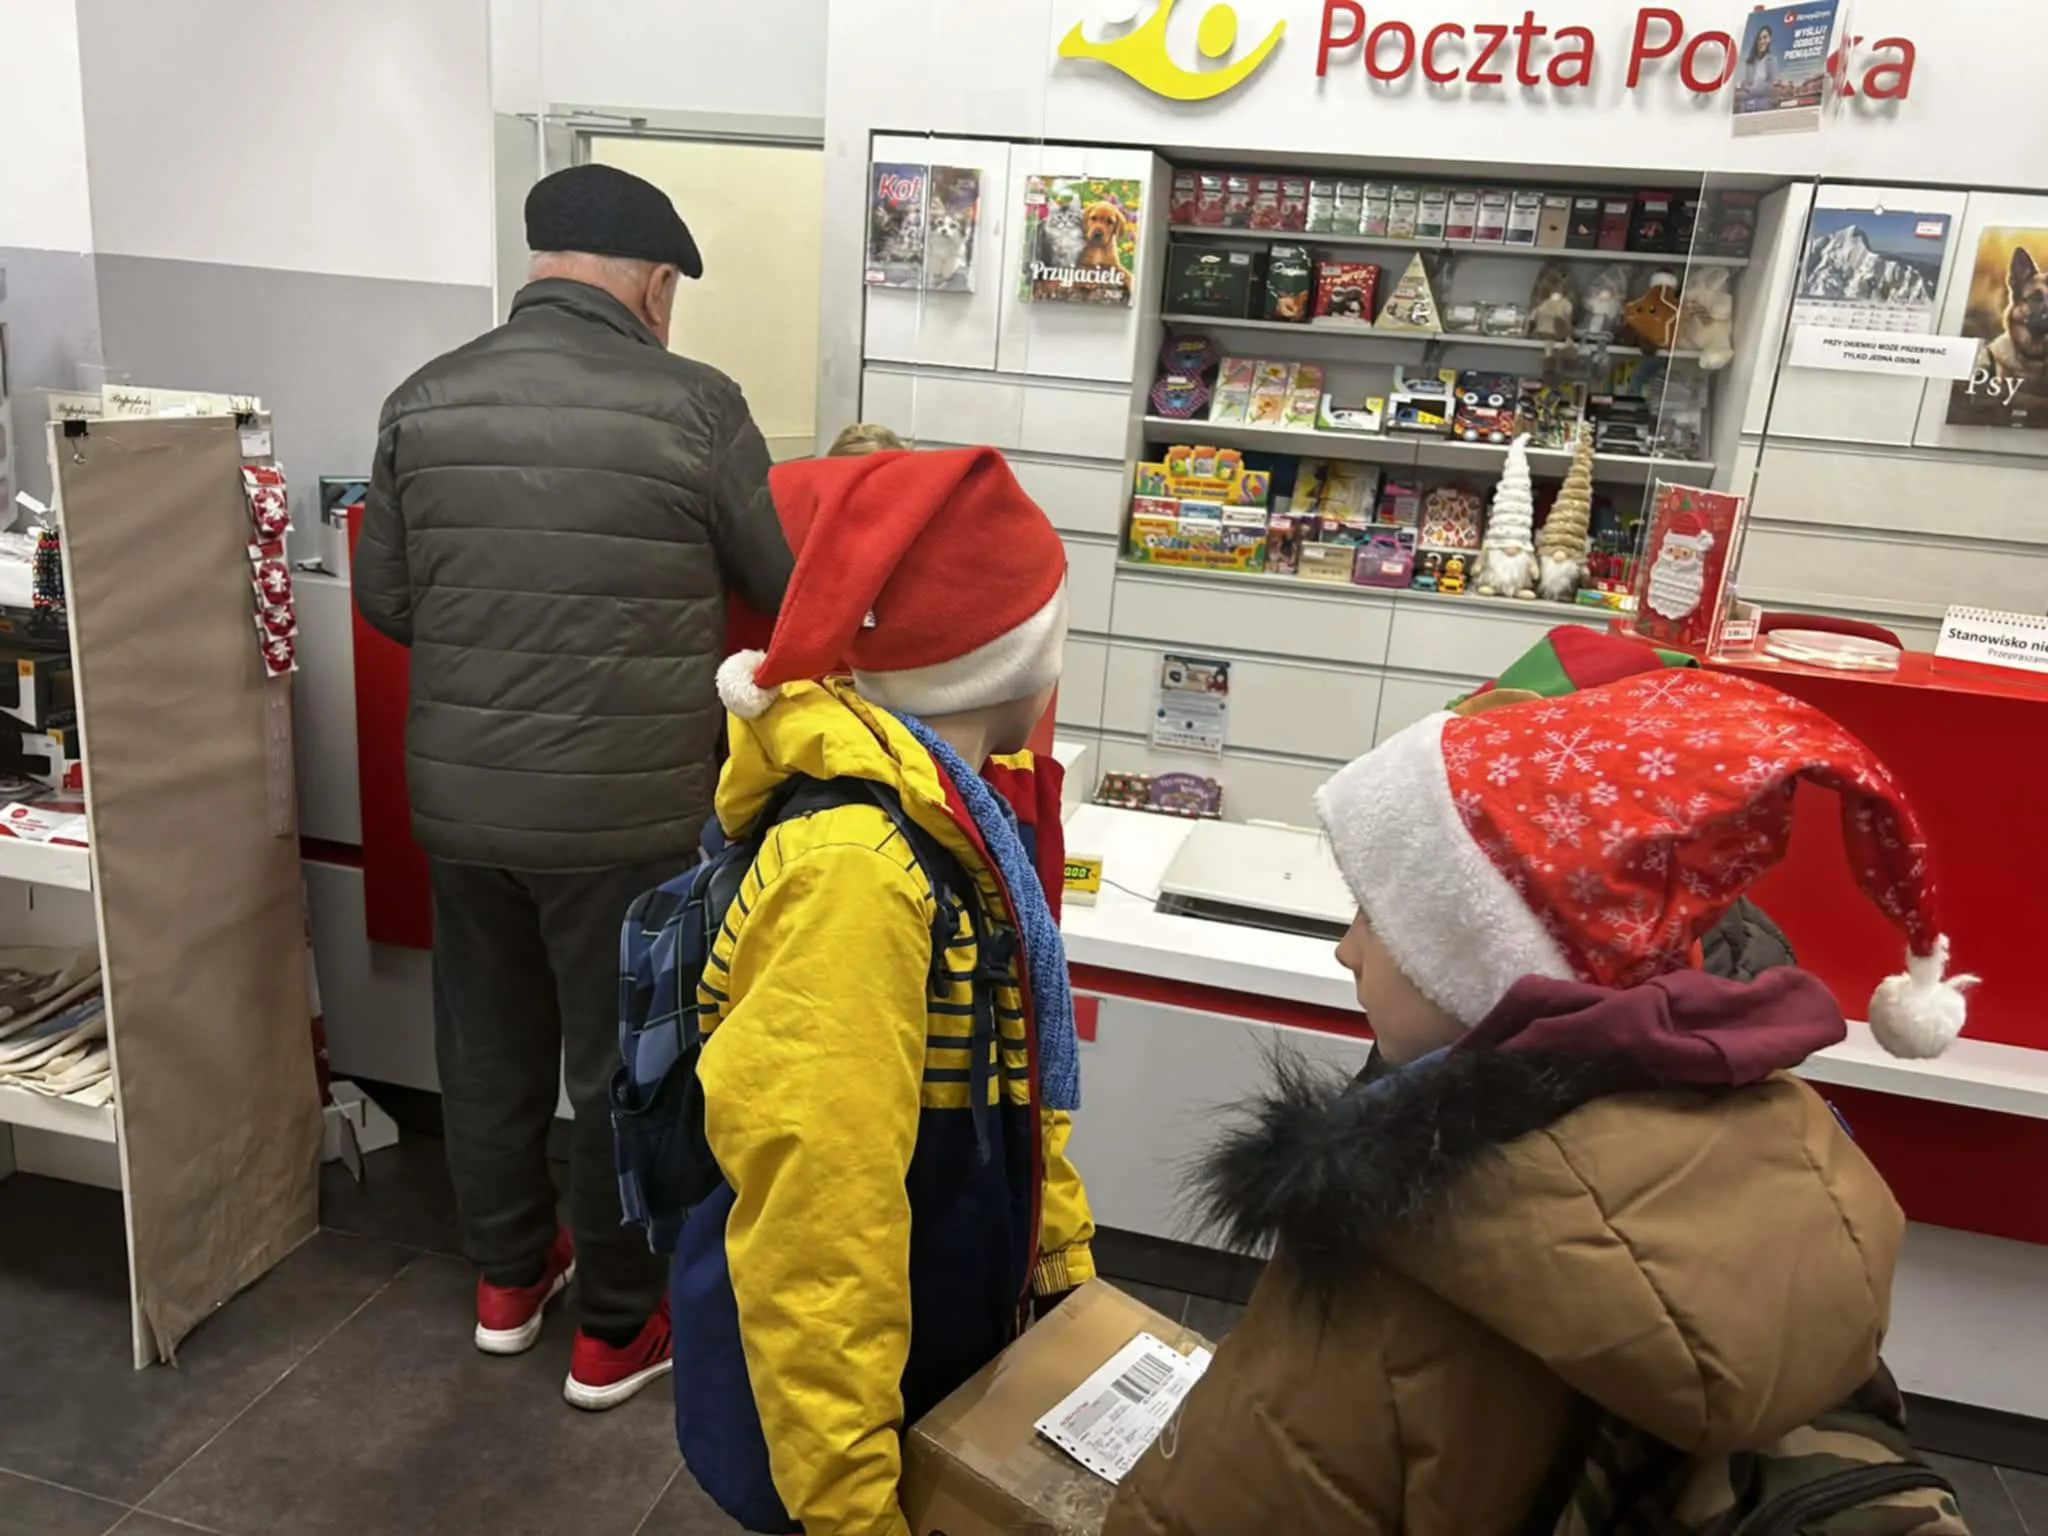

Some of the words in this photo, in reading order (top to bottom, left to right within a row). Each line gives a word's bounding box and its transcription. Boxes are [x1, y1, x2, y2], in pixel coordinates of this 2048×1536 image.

[1316, 0, 1595, 87] Poczta
[879, 173, 921, 201] Kot
[1030, 261, 1124, 287] Przyjaciele
[1823, 338, 1842, 347] PRZY
[1843, 340, 1876, 349] OKIENKU
[1843, 351, 1868, 360] TYLKO
[1868, 353, 1893, 362] JEDNA
[1894, 355, 1920, 364] OSOBA
[1964, 367, 2024, 405] Psy
[1948, 628, 2027, 648] Stanowisko
